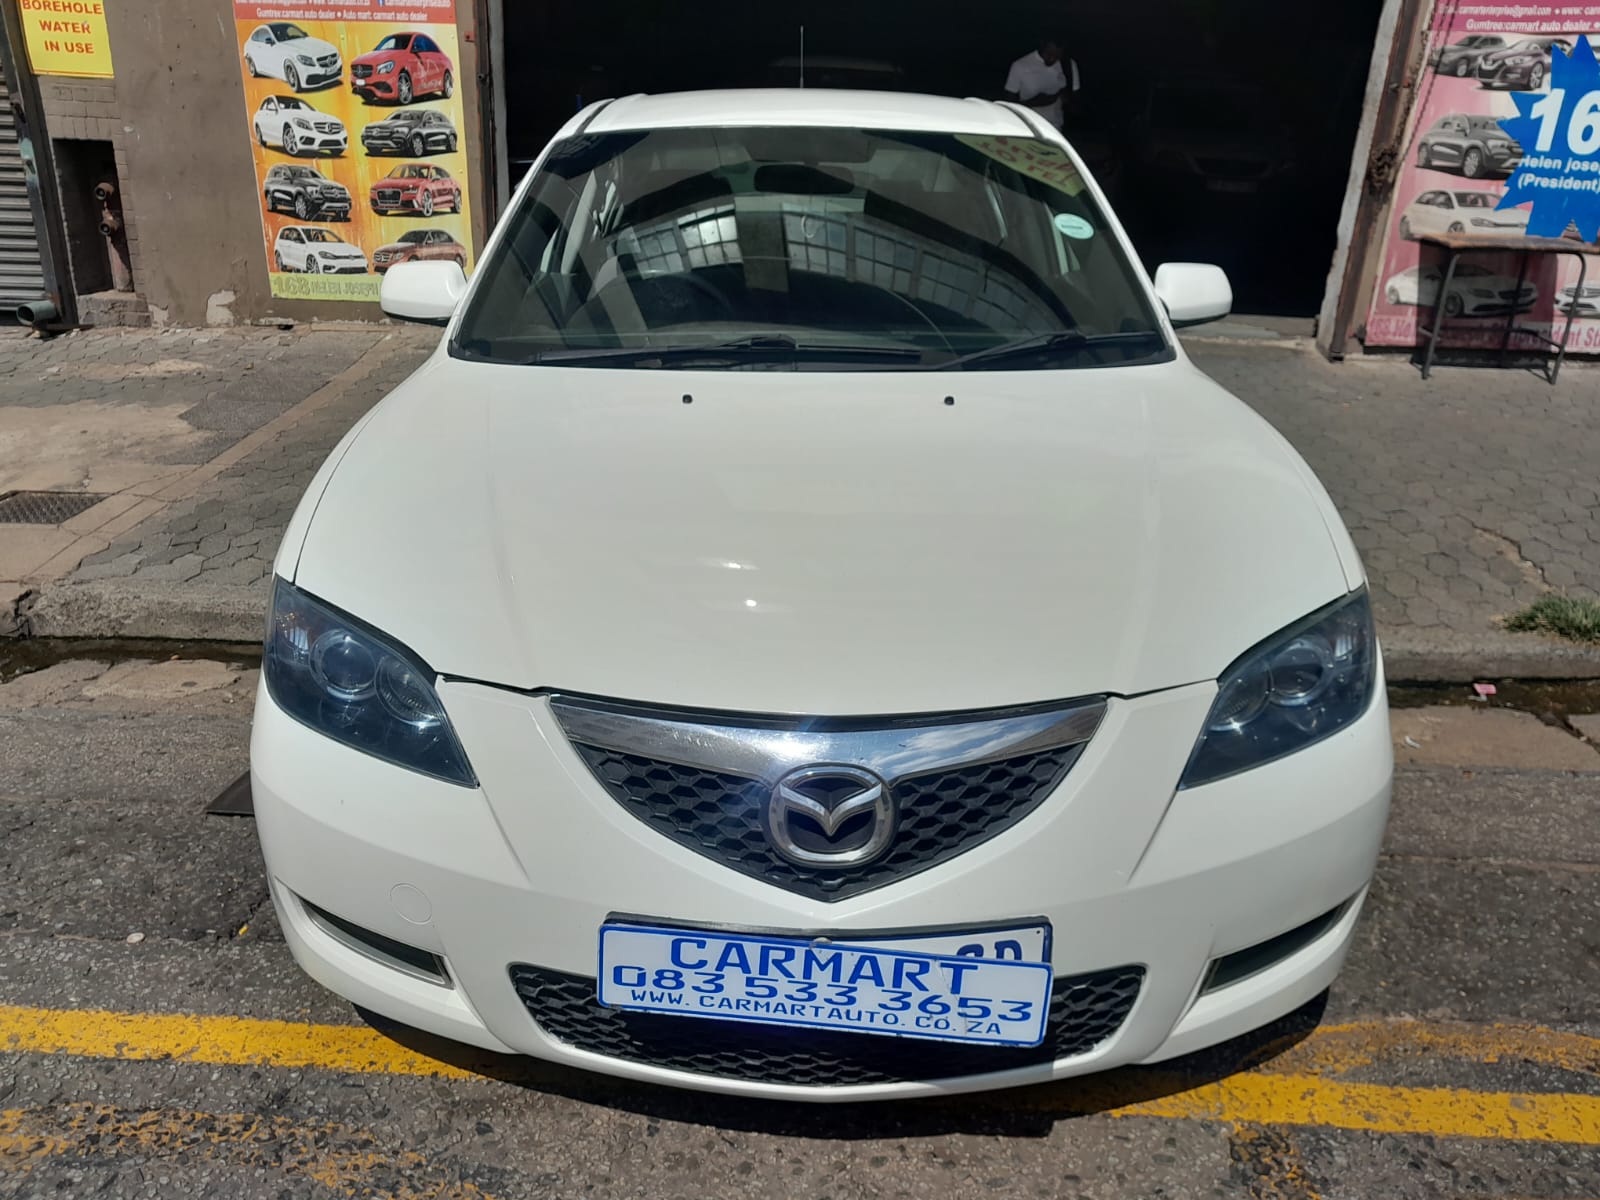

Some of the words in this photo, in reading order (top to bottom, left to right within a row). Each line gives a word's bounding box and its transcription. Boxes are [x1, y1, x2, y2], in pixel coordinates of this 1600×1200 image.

[22, 0, 102, 14] BOREHOLE
[39, 20, 91, 34] WATER
[1541, 21, 1561, 32] auto
[44, 40, 60, 52] IN
[64, 42, 94, 54] USE
[1519, 155, 1562, 170] Helen
[1564, 157, 1600, 173] jose
[670, 937, 978, 995] CARMART
[613, 965, 726, 994] 083
[745, 976, 858, 1006] 533
[878, 989, 1033, 1022] 3653
